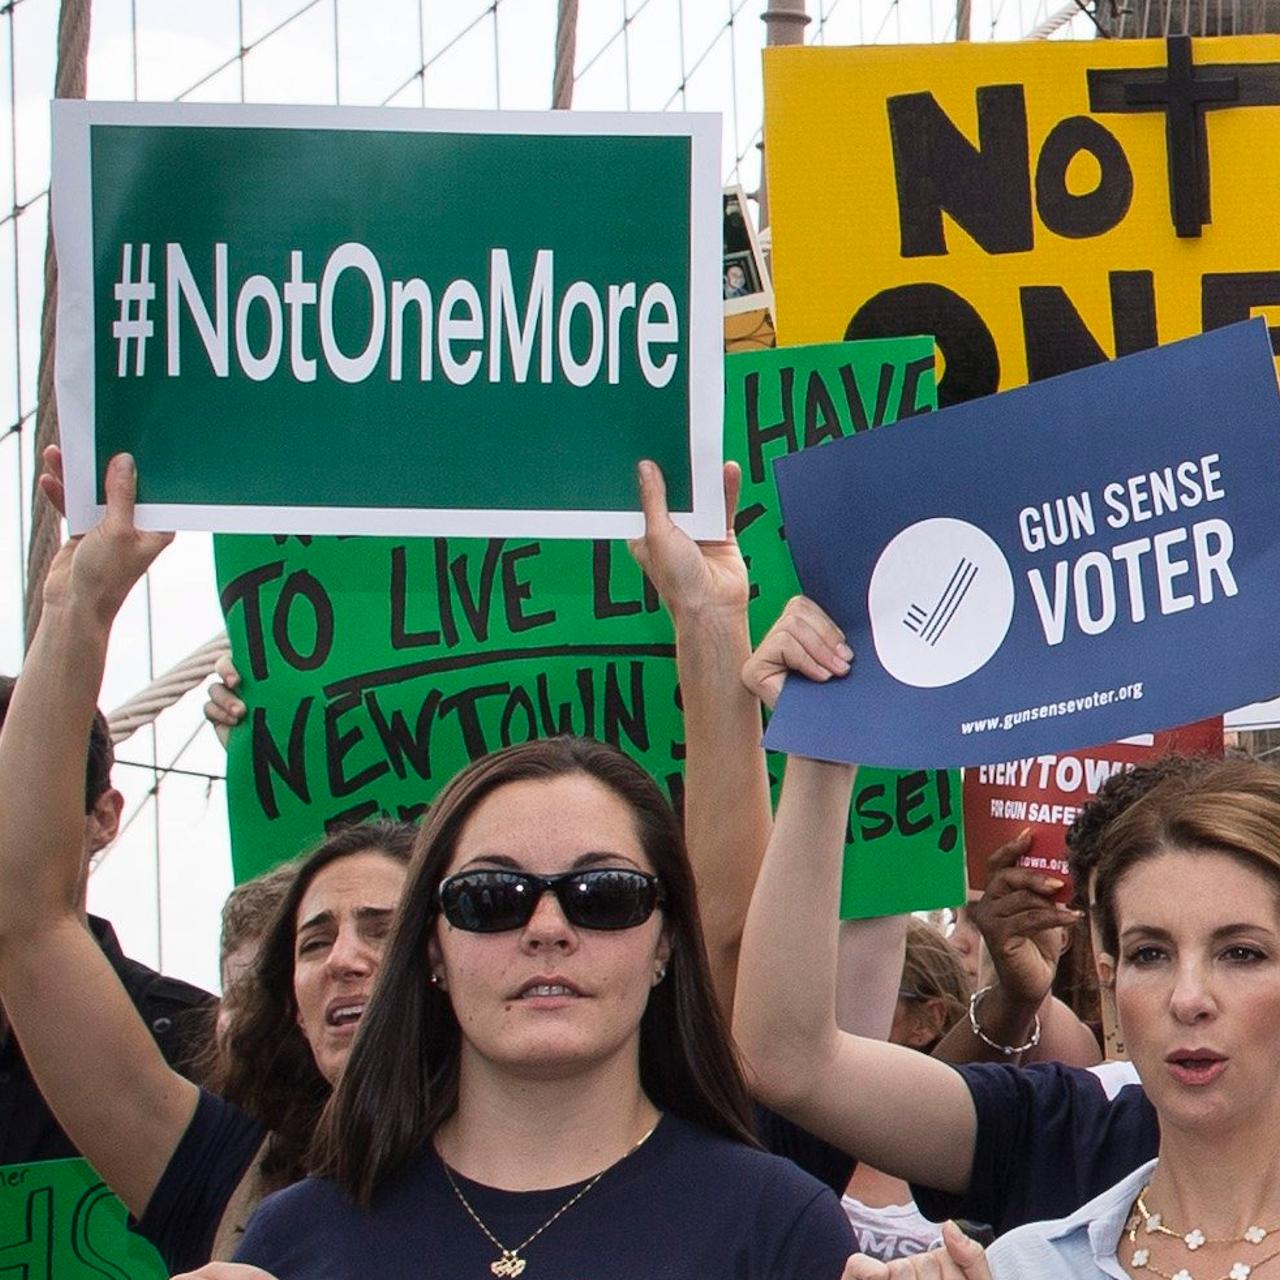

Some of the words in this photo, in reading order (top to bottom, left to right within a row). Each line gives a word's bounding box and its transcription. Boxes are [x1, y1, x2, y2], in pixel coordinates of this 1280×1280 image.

[112, 242, 679, 388] #NotOneMore
[1018, 491, 1096, 553] GUN
[1103, 453, 1226, 529] SENSE
[219, 558, 335, 681] TO
[390, 537, 557, 652] LIVE
[1026, 518, 1239, 646] VOTER
[250, 660, 650, 820] NEWTOWN
[960, 681, 1145, 736] www.gunsensevoter.org
[979, 754, 1136, 795] EVERYTOW
[1027, 802, 1084, 826] SAFE
